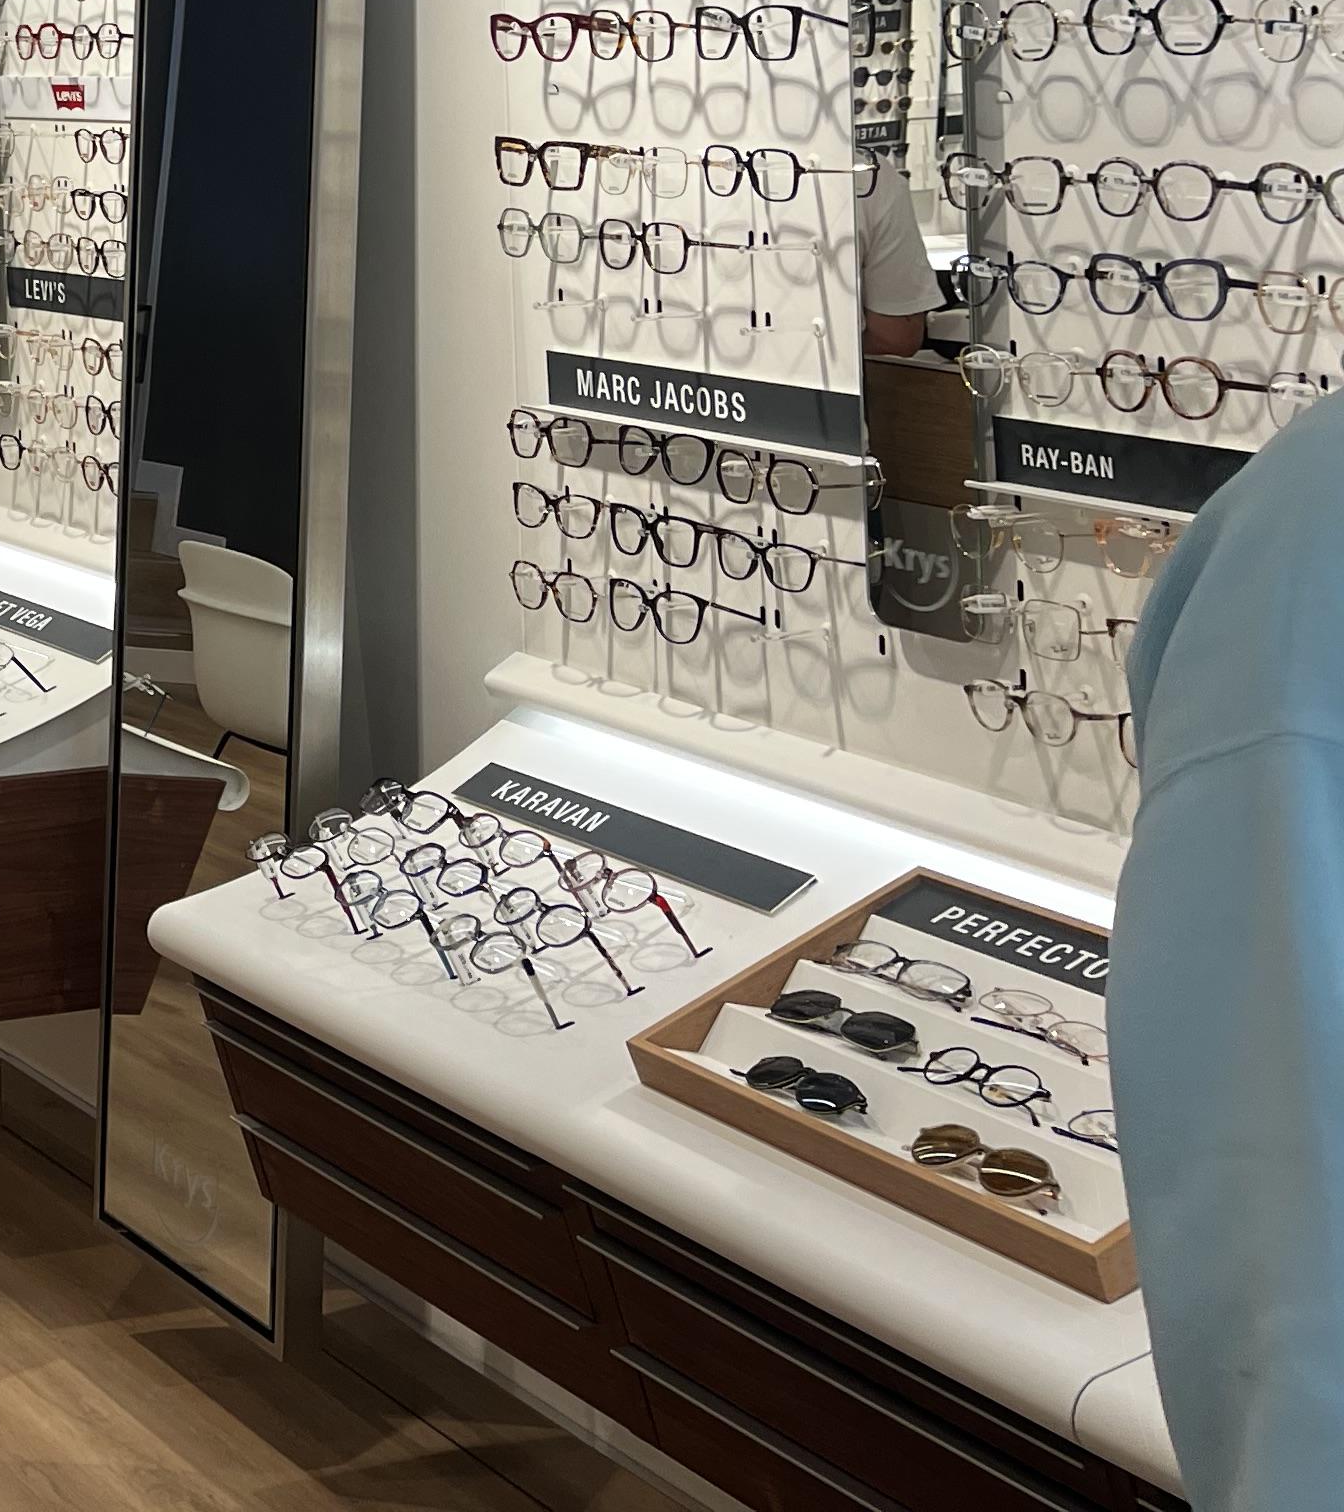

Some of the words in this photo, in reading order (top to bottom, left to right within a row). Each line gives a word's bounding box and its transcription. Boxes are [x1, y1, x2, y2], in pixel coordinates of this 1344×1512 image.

[25, 278, 66, 304] LEVI'S
[576, 368, 641, 406] MARC
[650, 380, 746, 423] JACOBS
[1021, 444, 1114, 480] RAY-BAN
[883, 538, 951, 585] Krys
[9, 606, 53, 631] VEGA
[490, 779, 611, 833] KARAVAN
[929, 905, 1111, 979] PERFECTO
